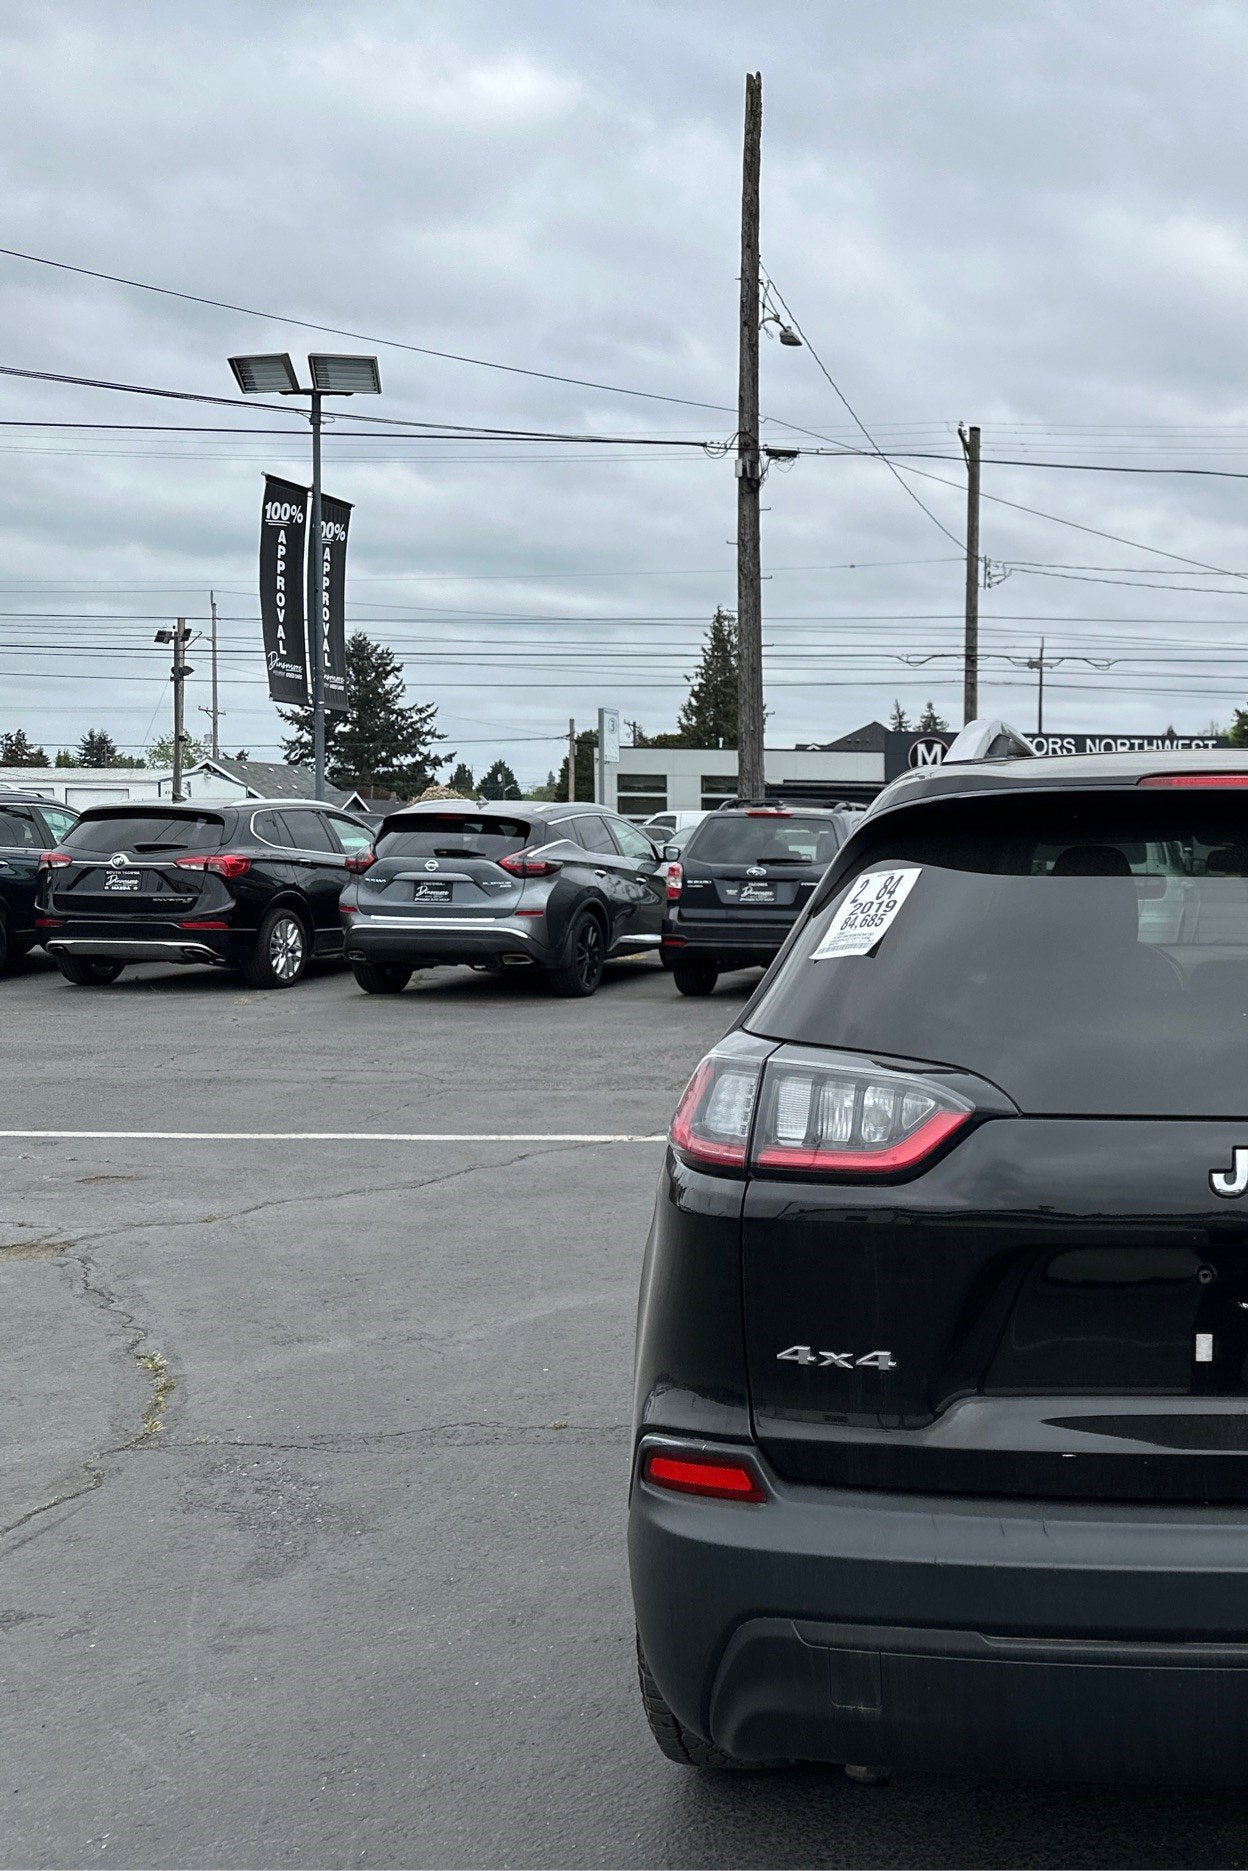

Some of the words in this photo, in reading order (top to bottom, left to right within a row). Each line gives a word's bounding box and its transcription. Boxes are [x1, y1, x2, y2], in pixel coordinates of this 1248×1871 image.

[265, 501, 304, 524] 100%
[321, 521, 346, 542] 00%
[276, 529, 287, 655] APPROVAL
[322, 547, 331, 667] APPROVAL
[917, 743, 943, 766] M
[875, 874, 904, 901] 84
[848, 899, 898, 917] 2019
[777, 1345, 897, 1371] 4x4
